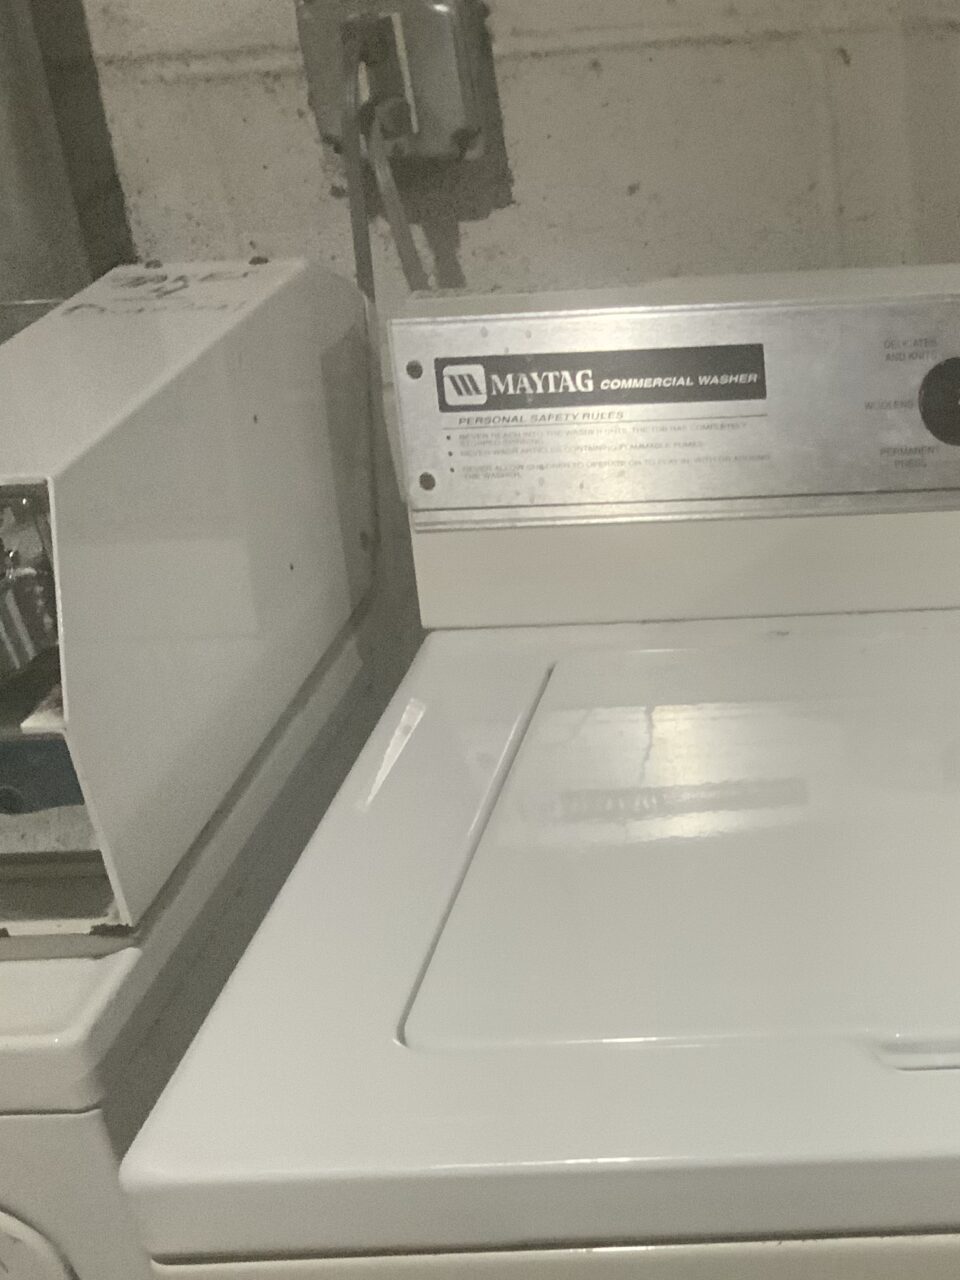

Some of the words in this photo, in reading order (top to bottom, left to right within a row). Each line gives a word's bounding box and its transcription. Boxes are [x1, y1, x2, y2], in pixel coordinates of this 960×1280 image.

[489, 369, 594, 396] MAYTAG
[600, 376, 694, 391] COMMERCIAL
[698, 373, 758, 387] WASHER
[458, 415, 525, 426] PERSONAL
[530, 412, 579, 423] SAFETY
[582, 411, 624, 422] RULES
